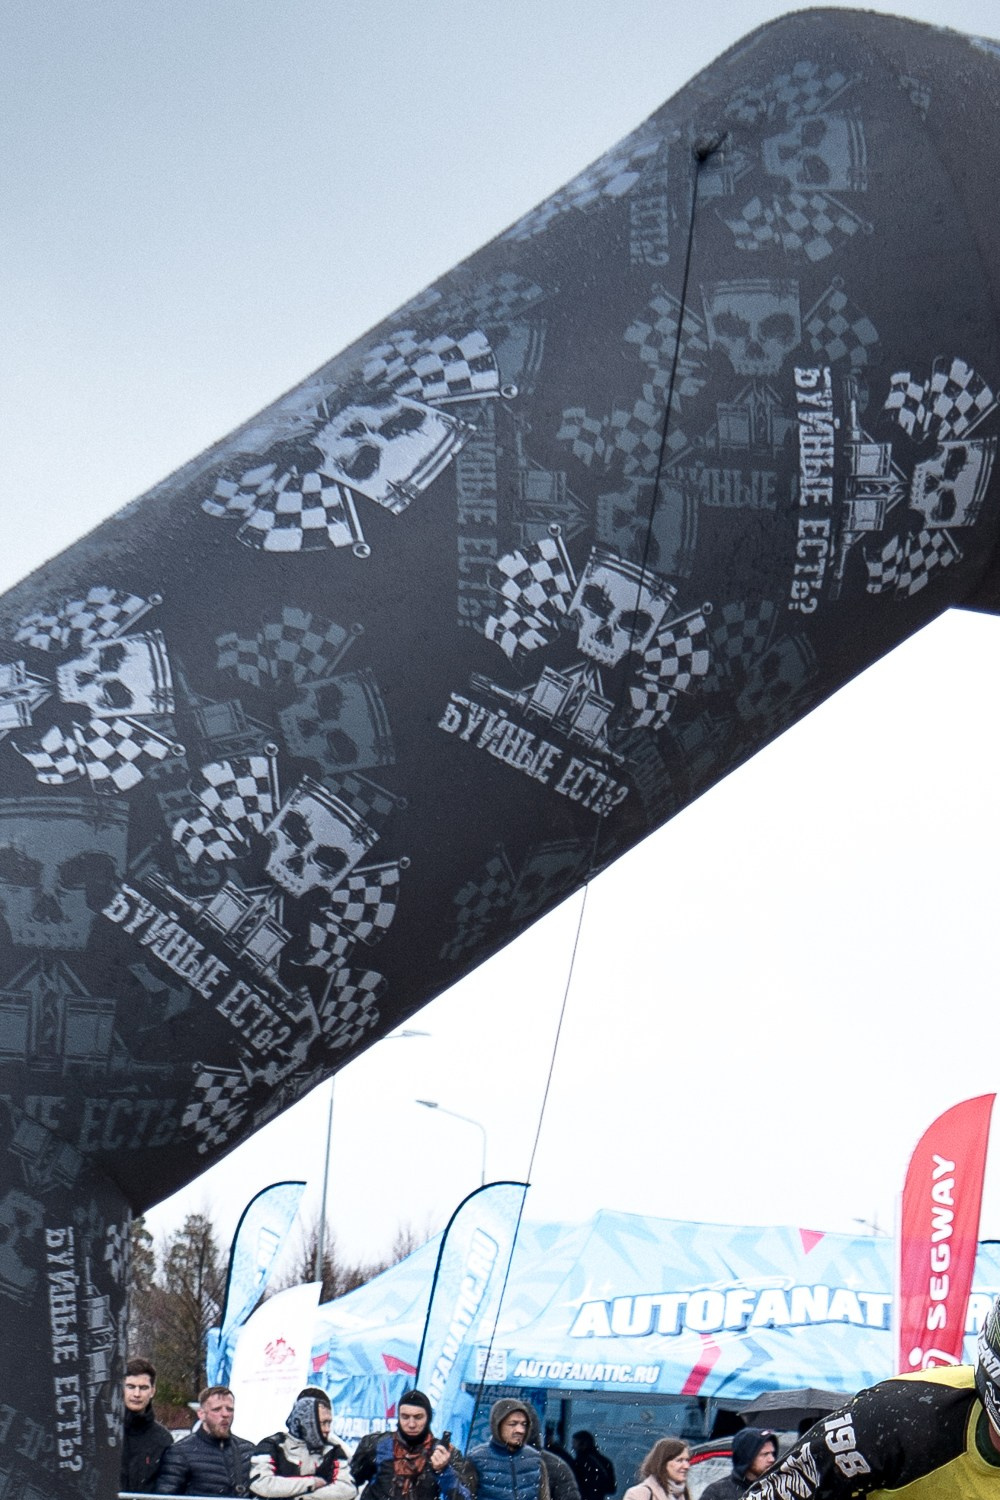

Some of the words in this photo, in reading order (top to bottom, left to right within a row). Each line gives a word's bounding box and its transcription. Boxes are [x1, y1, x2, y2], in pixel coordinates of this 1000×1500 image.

[793, 366, 841, 507] БУЙНЫЕ
[787, 518, 836, 615] ЕСТЬ?
[437, 691, 564, 785] БУЙНЫЕ
[554, 757, 630, 818] ЕСТЬ?
[102, 883, 232, 1000] БУЙНЫЕ
[215, 979, 292, 1056] ЕСТЬ?
[45, 1226, 80, 1364] БУЙНЫЕ
[926, 1153, 956, 1331] SEGWAY
[54, 1373, 84, 1472] ЕСТЬ?
[513, 1359, 661, 1385] AUTOFANATIC.RU
[824, 1412, 872, 1479] 198
